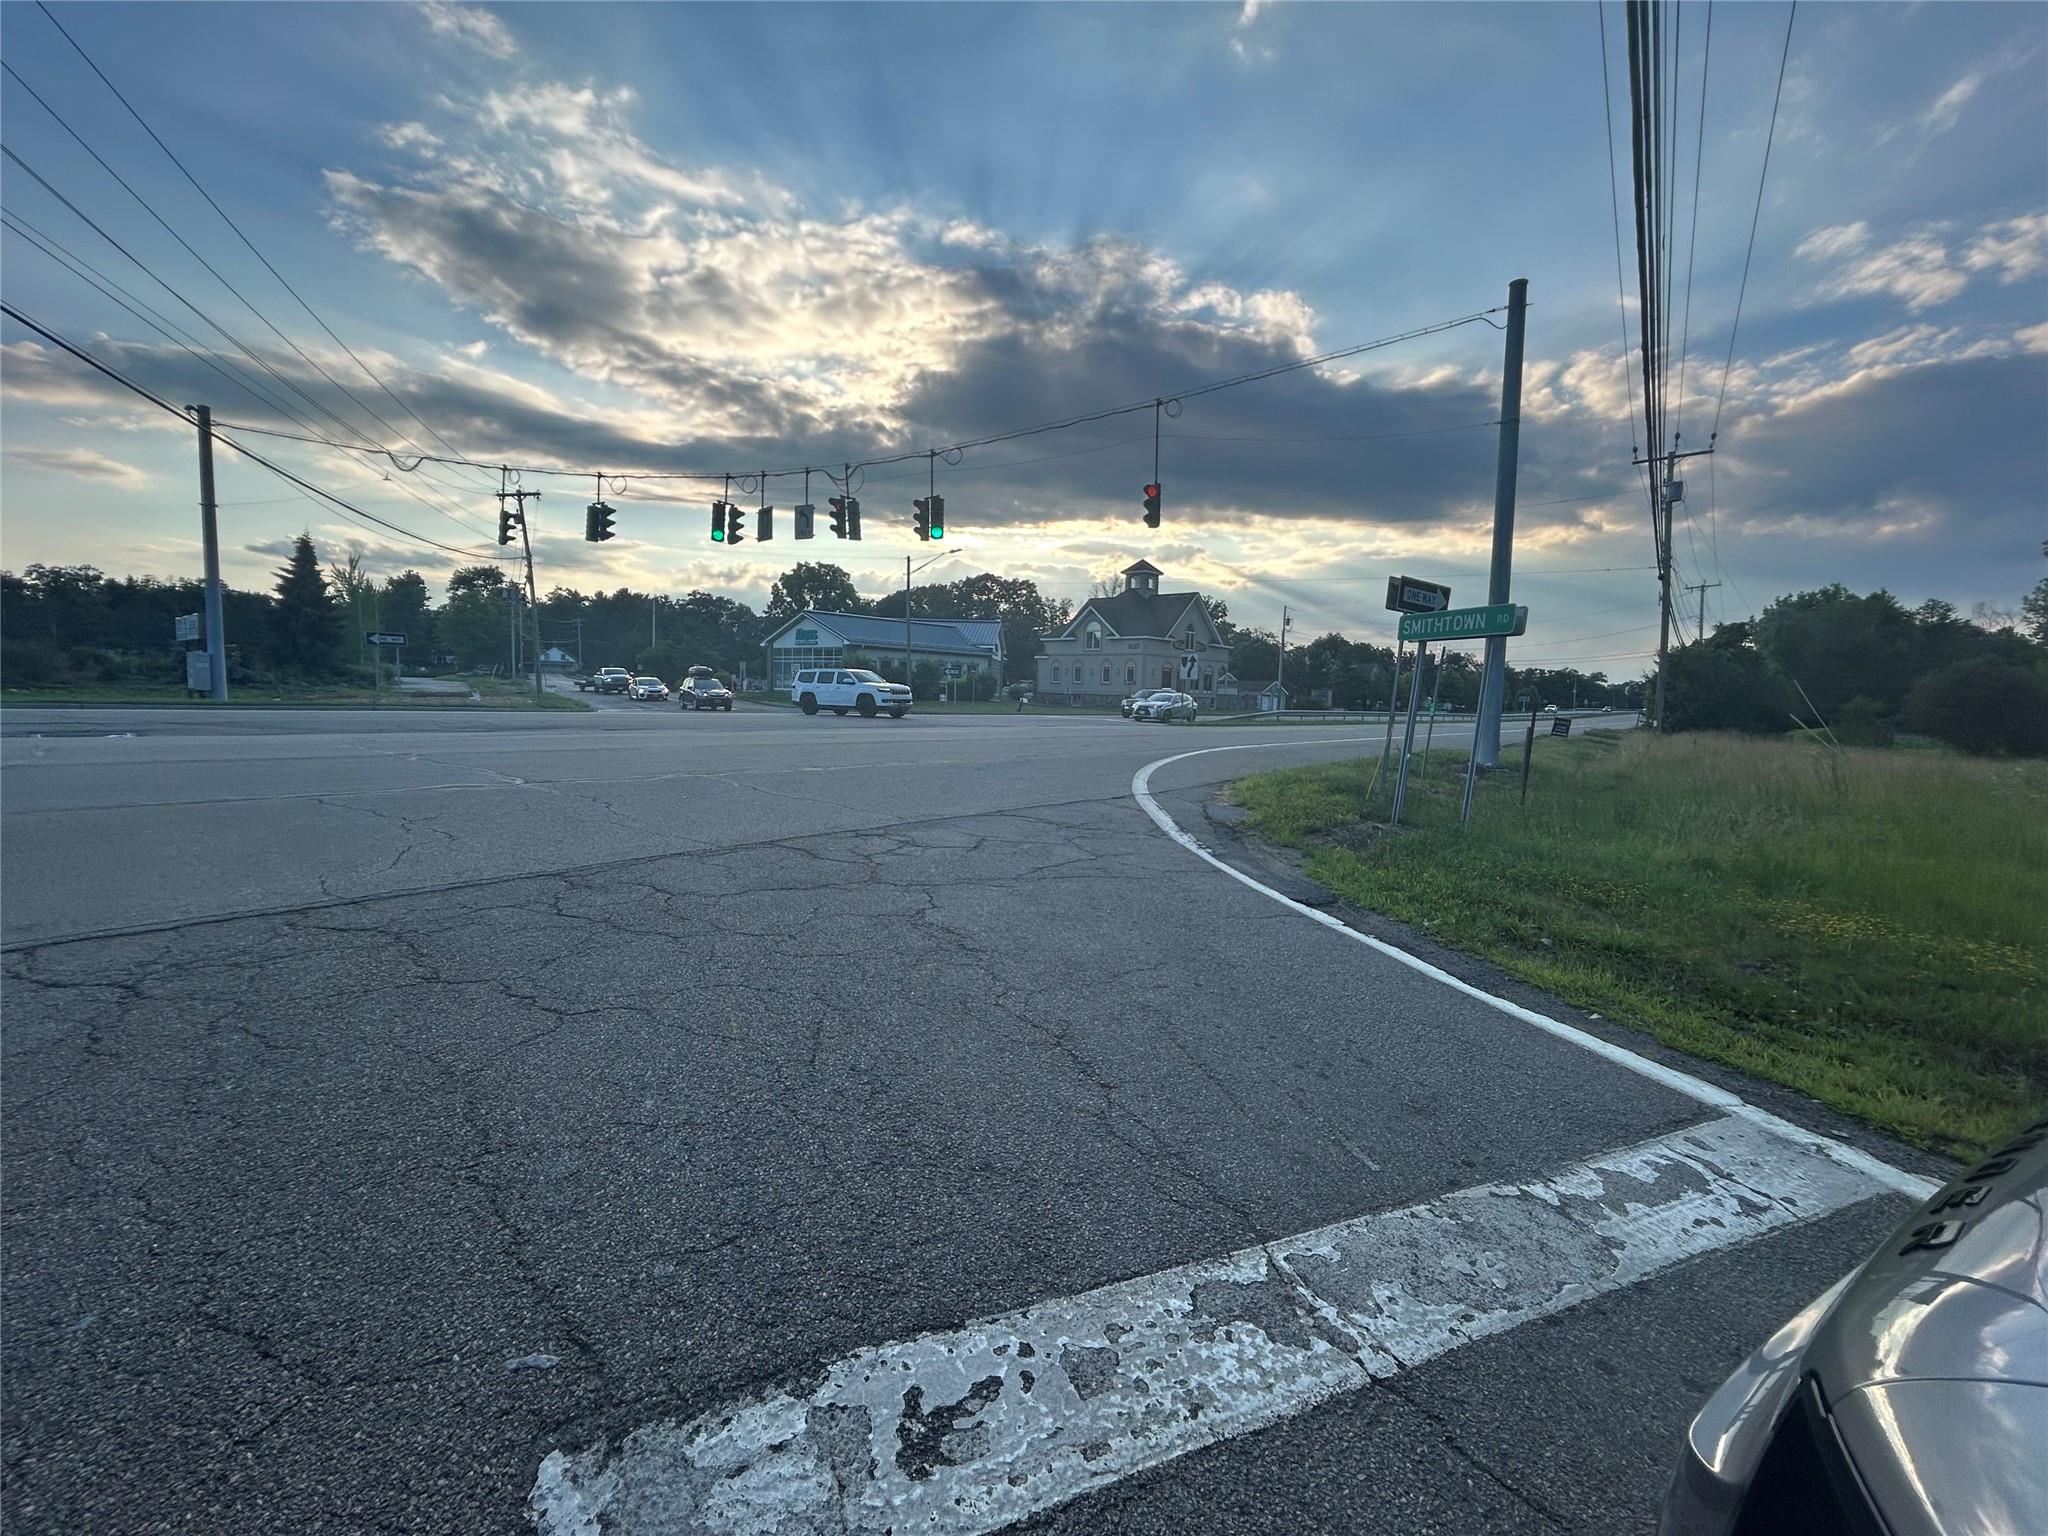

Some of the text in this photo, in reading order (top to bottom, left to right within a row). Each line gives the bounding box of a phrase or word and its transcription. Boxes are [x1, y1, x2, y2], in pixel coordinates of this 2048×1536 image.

[1407, 589, 1437, 606] ONE WAY
[1402, 612, 1487, 635] SMITHTOWN
